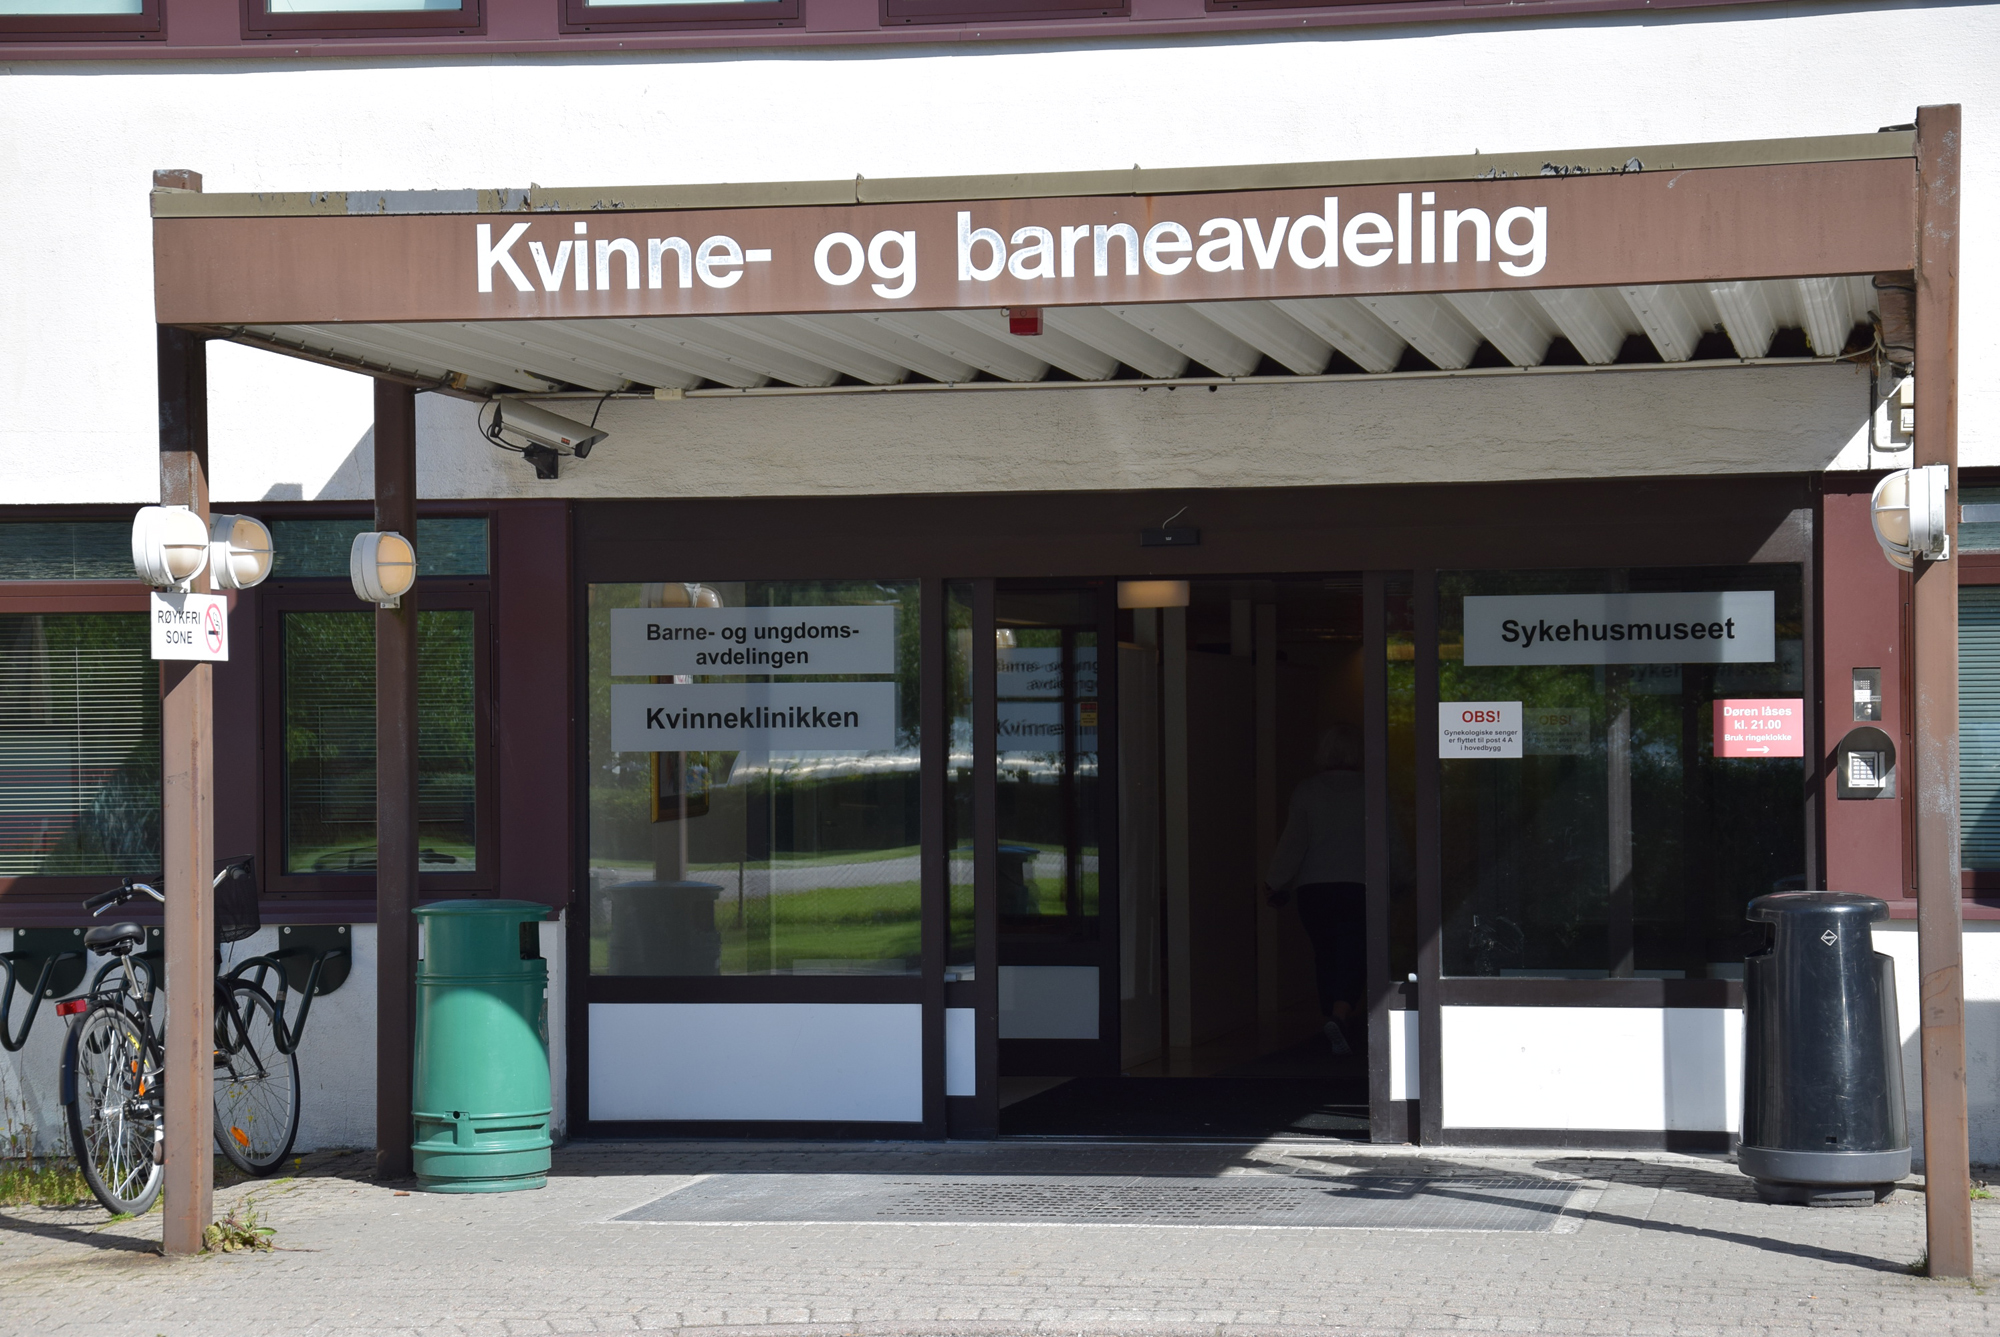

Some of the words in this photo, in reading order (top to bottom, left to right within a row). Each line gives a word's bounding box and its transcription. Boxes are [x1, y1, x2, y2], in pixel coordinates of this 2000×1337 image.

[476, 221, 772, 293] Kvinne-
[813, 230, 917, 299] og
[957, 191, 1547, 282] barneavdeling
[158, 609, 201, 625] RØYKFRI
[165, 630, 193, 645] SONE
[646, 623, 716, 641] Barne-
[721, 626, 747, 645] og
[754, 621, 860, 644] ungdoms-
[1501, 617, 1735, 648] Sykehusmuseet
[695, 647, 809, 668] avdelingen
[646, 706, 859, 730] Kvinneklinikken
[1461, 710, 1501, 723] OBS!
[1723, 706, 1759, 717] Døren
[1761, 705, 1793, 717] låses
[1734, 719, 1748, 730] kl.
[1751, 719, 1782, 730] 21.00
[1443, 729, 1493, 737] Gynekologiske
[1724, 733, 1744, 742] Bruk
[1745, 733, 1792, 743] ringeklokke
[1457, 737, 1476, 745] flyttet
[1485, 737, 1501, 745] post
[1464, 744, 1502, 753] hovedbygg
